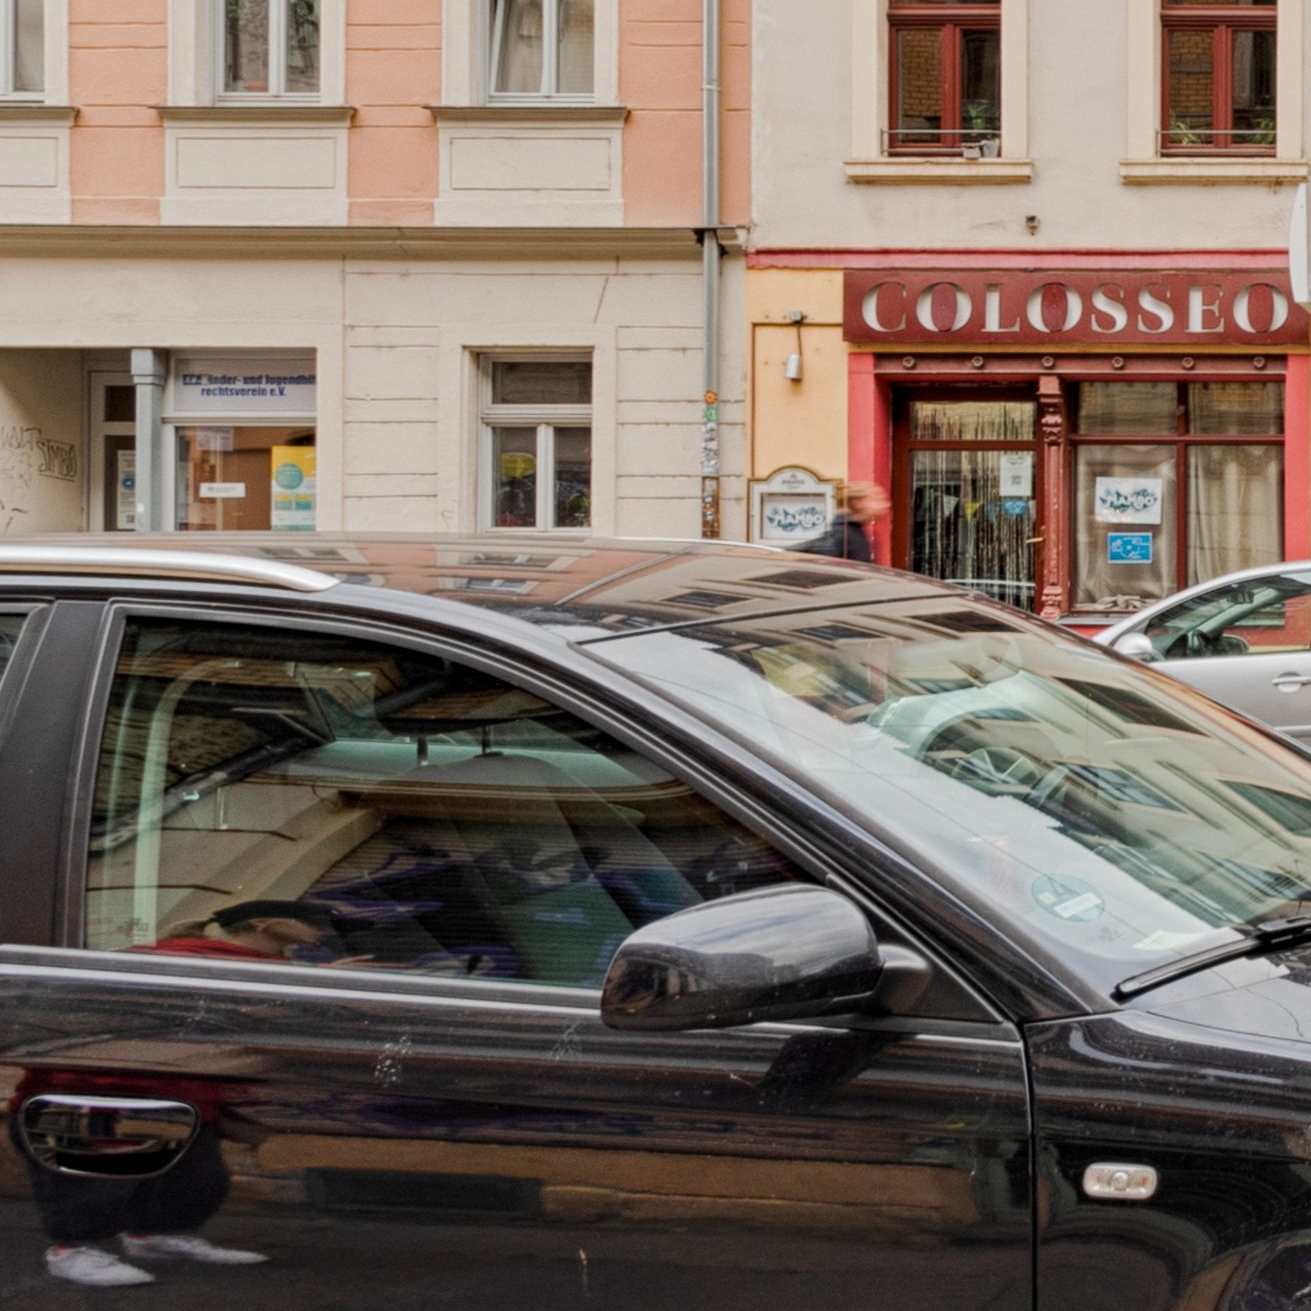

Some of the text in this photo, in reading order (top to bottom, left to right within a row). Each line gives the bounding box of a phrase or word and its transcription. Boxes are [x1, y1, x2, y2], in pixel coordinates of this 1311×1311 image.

[861, 281, 1290, 334] COLOSSEO
[204, 374, 241, 385] inder-
[201, 386, 267, 396] rechtsverein
